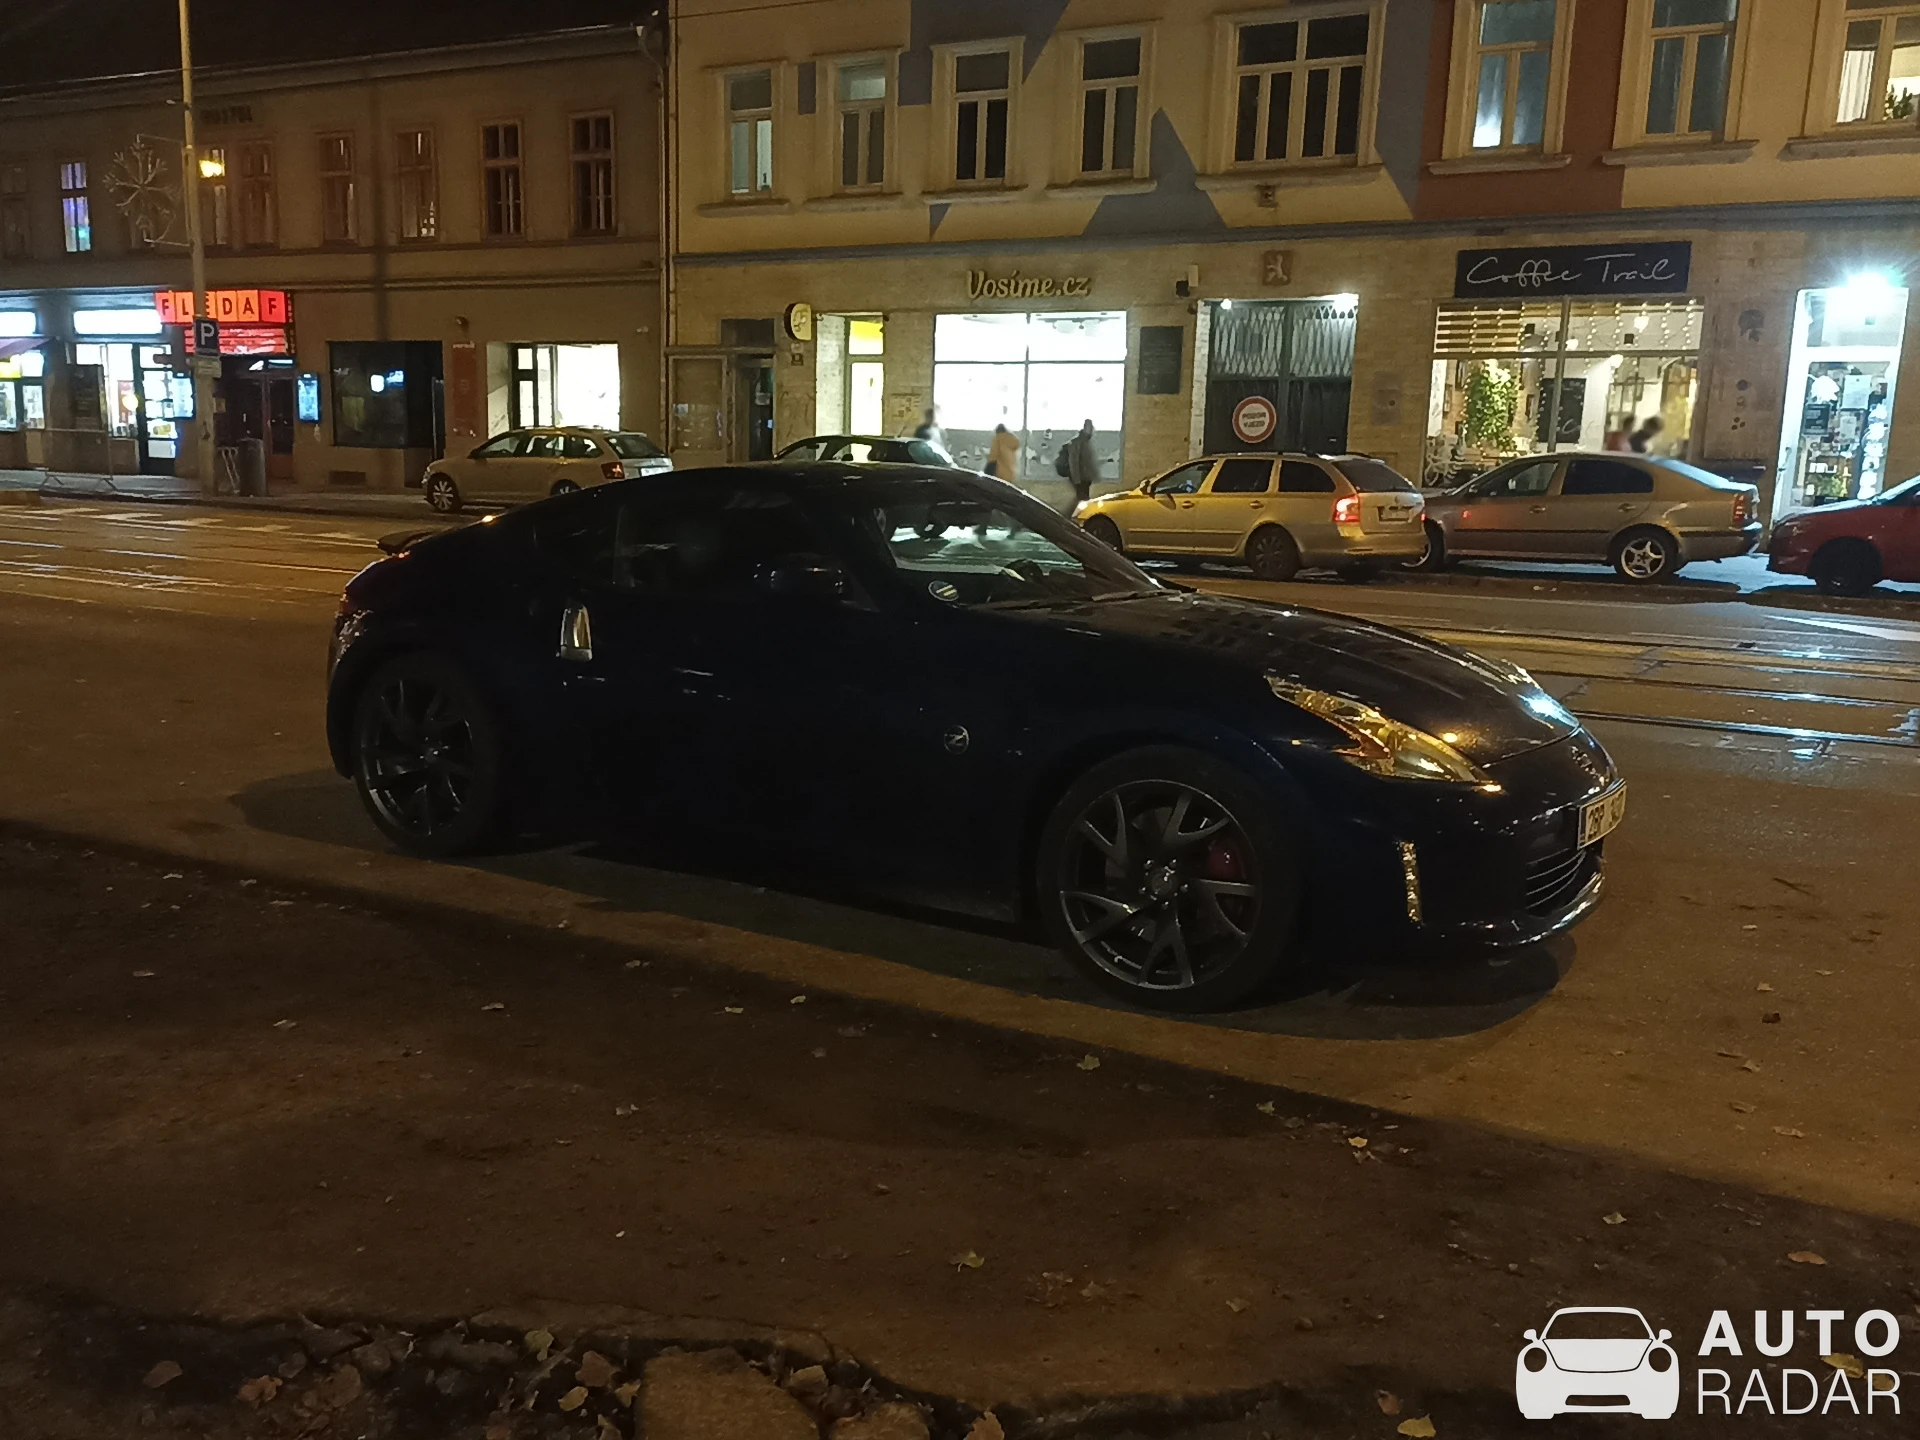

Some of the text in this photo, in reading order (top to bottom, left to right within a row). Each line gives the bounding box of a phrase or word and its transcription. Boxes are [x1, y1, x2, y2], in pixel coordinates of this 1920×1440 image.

[967, 269, 1090, 299] Vosíme.cz
[1466, 253, 1676, 288] Coffee Trail
[200, 322, 215, 346] P
